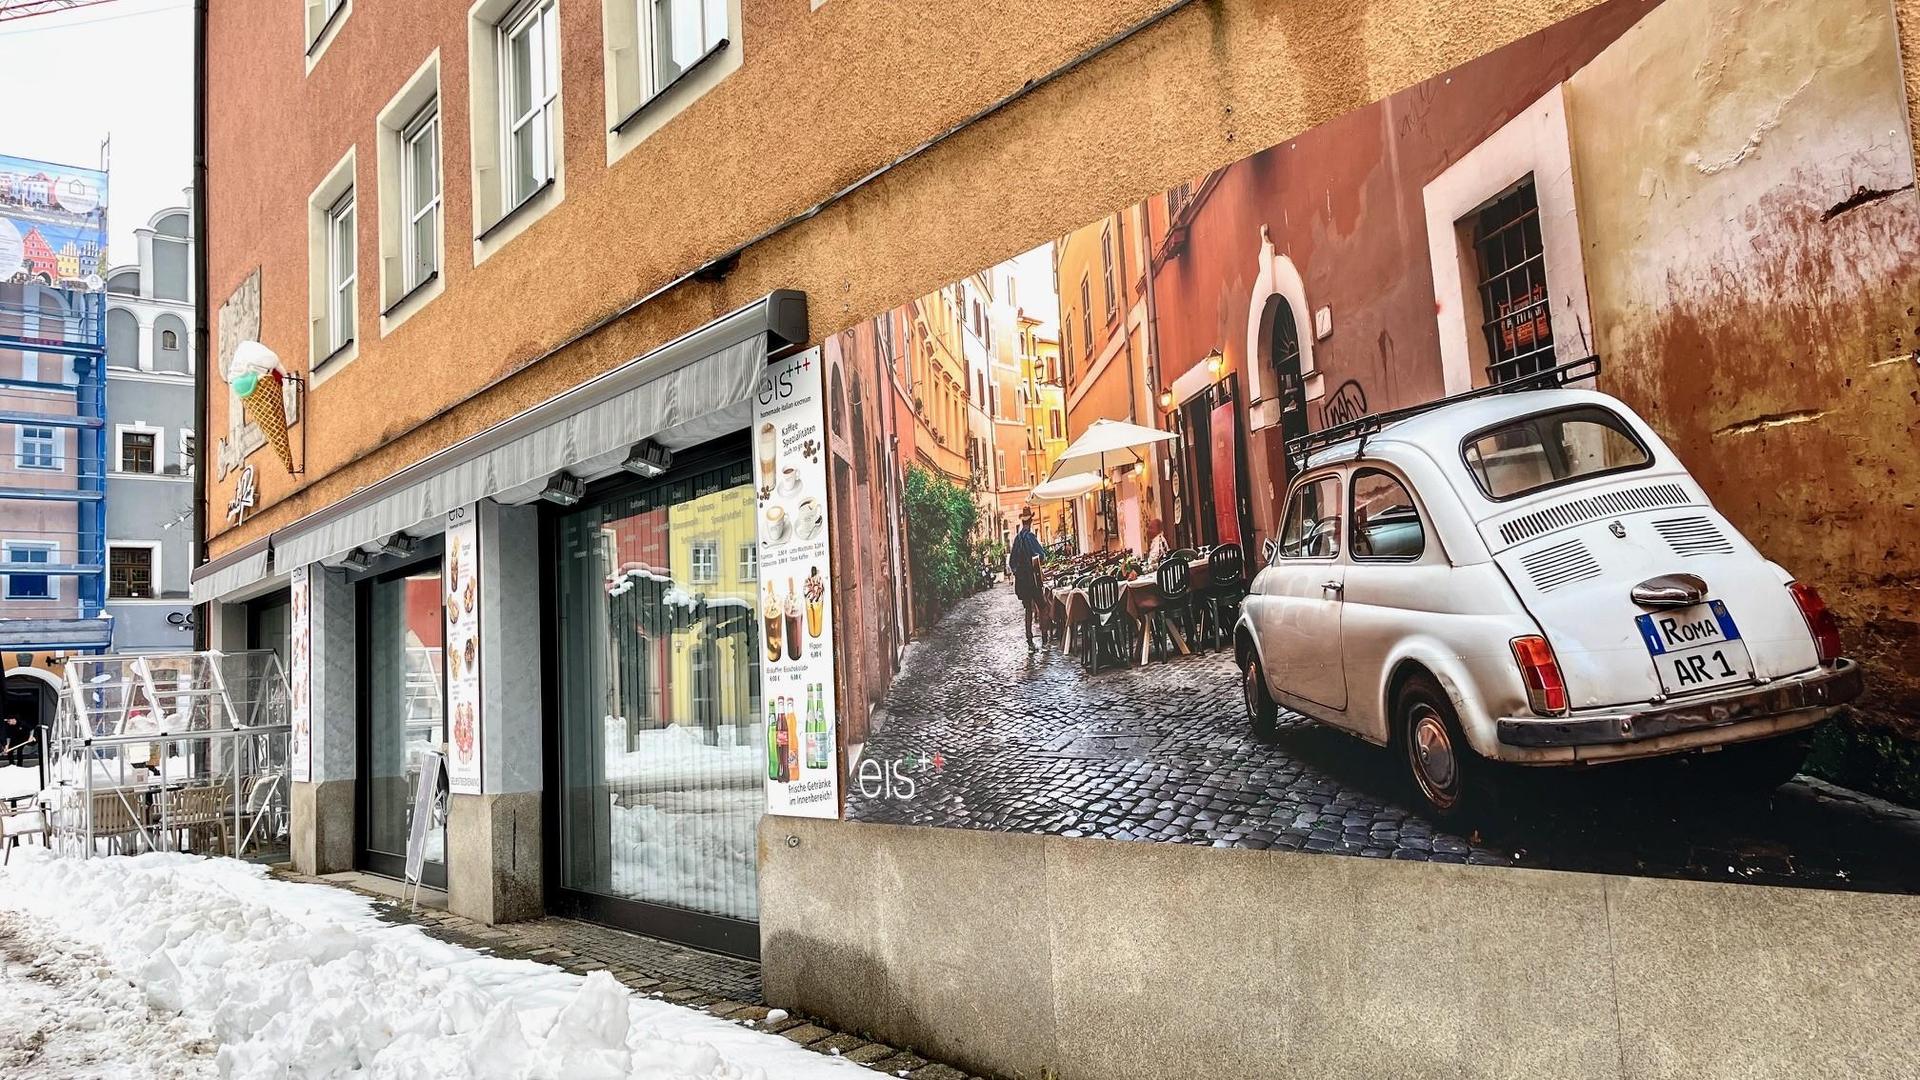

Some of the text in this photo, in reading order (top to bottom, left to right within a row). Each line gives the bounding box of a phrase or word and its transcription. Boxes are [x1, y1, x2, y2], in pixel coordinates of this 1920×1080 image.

[781, 422, 799, 436] Kaffee
[782, 424, 816, 448] Spezialitäten
[1673, 649, 1738, 687] AR 1
[788, 779, 832, 794] Frische Getränke
[796, 791, 833, 804] Innenbereich!
